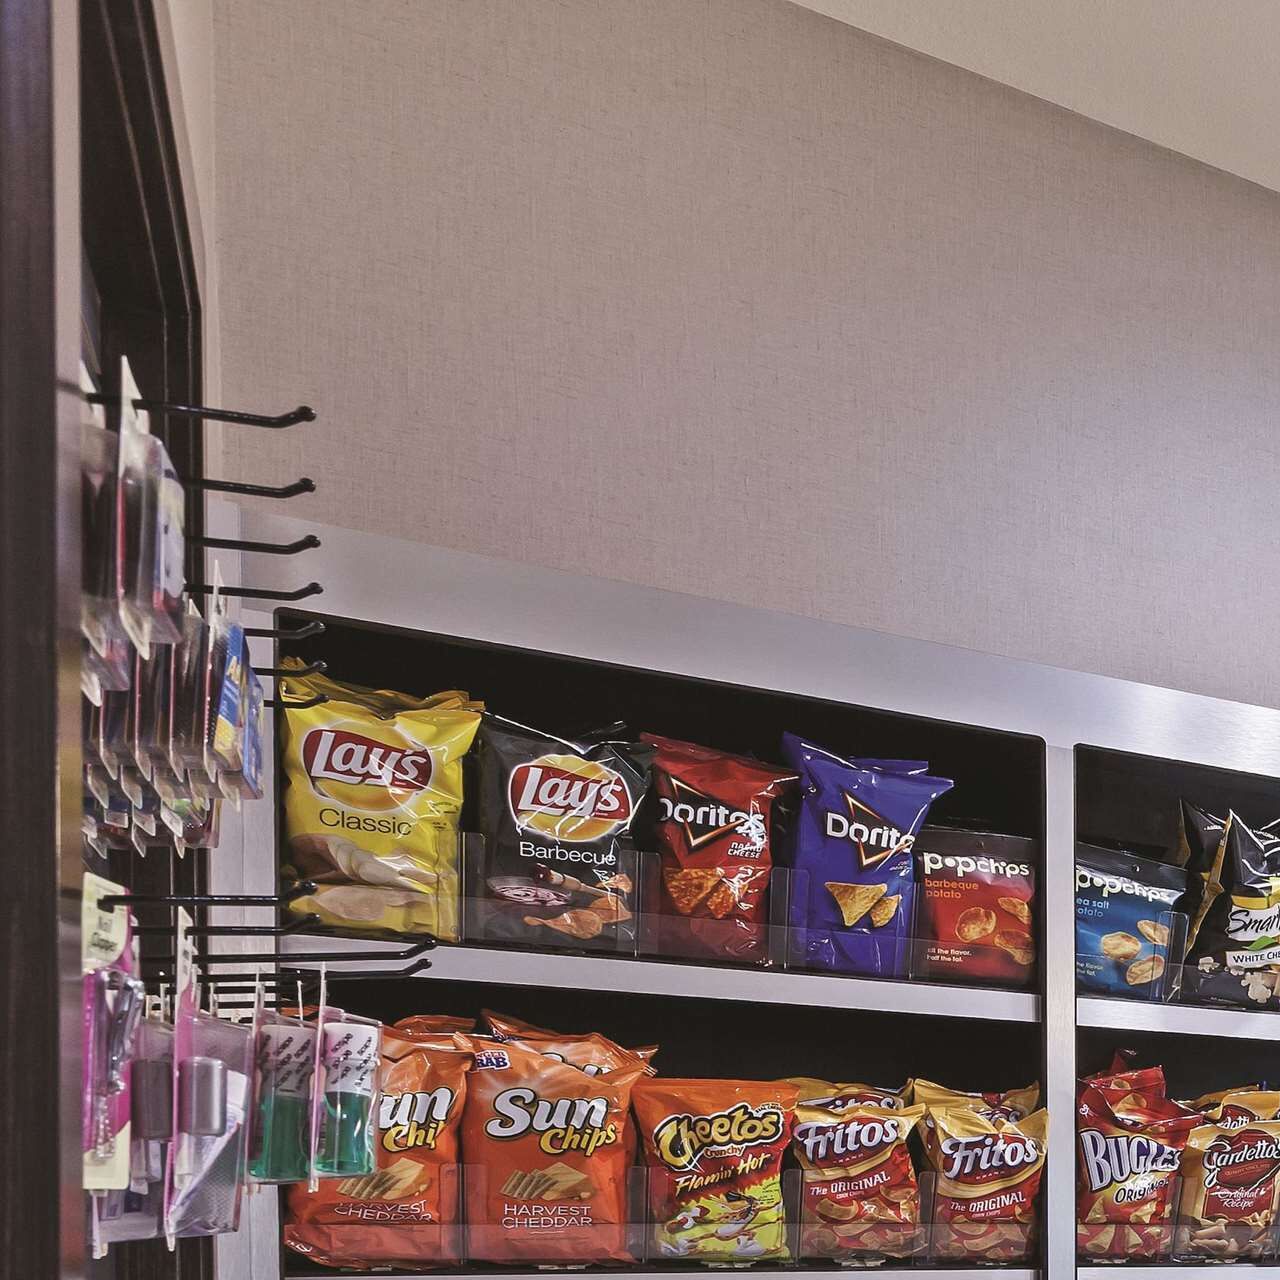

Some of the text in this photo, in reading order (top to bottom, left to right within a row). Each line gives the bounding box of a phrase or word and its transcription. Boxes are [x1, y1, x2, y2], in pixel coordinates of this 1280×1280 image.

[310, 730, 428, 788] Lay's
[517, 767, 624, 817] Lay's
[319, 806, 413, 837] Classic
[519, 840, 617, 866] Barbecue
[727, 848, 762, 860] CHEESE
[922, 851, 1031, 878] popchips
[924, 878, 979, 891] barbeque
[926, 889, 962, 900] potato
[1091, 898, 1110, 910] salt
[1233, 952, 1265, 964] WHITE
[485, 1088, 608, 1138] Sun
[540, 1121, 618, 1157] Chips
[655, 1106, 782, 1168] Cheetos
[801, 1118, 899, 1162] Fritos
[703, 1144, 745, 1159] Crunchy
[940, 1133, 1039, 1179] Fritos
[1079, 1128, 1182, 1192] BUGLES
[675, 1151, 770, 1194] Flamin' Hot
[809, 1170, 892, 1197] The ORIGINAL
[504, 1203, 592, 1217] HARVEST
[968, 1191, 1027, 1214] ORIGINAL
[502, 1216, 593, 1230] CHEDDAR
